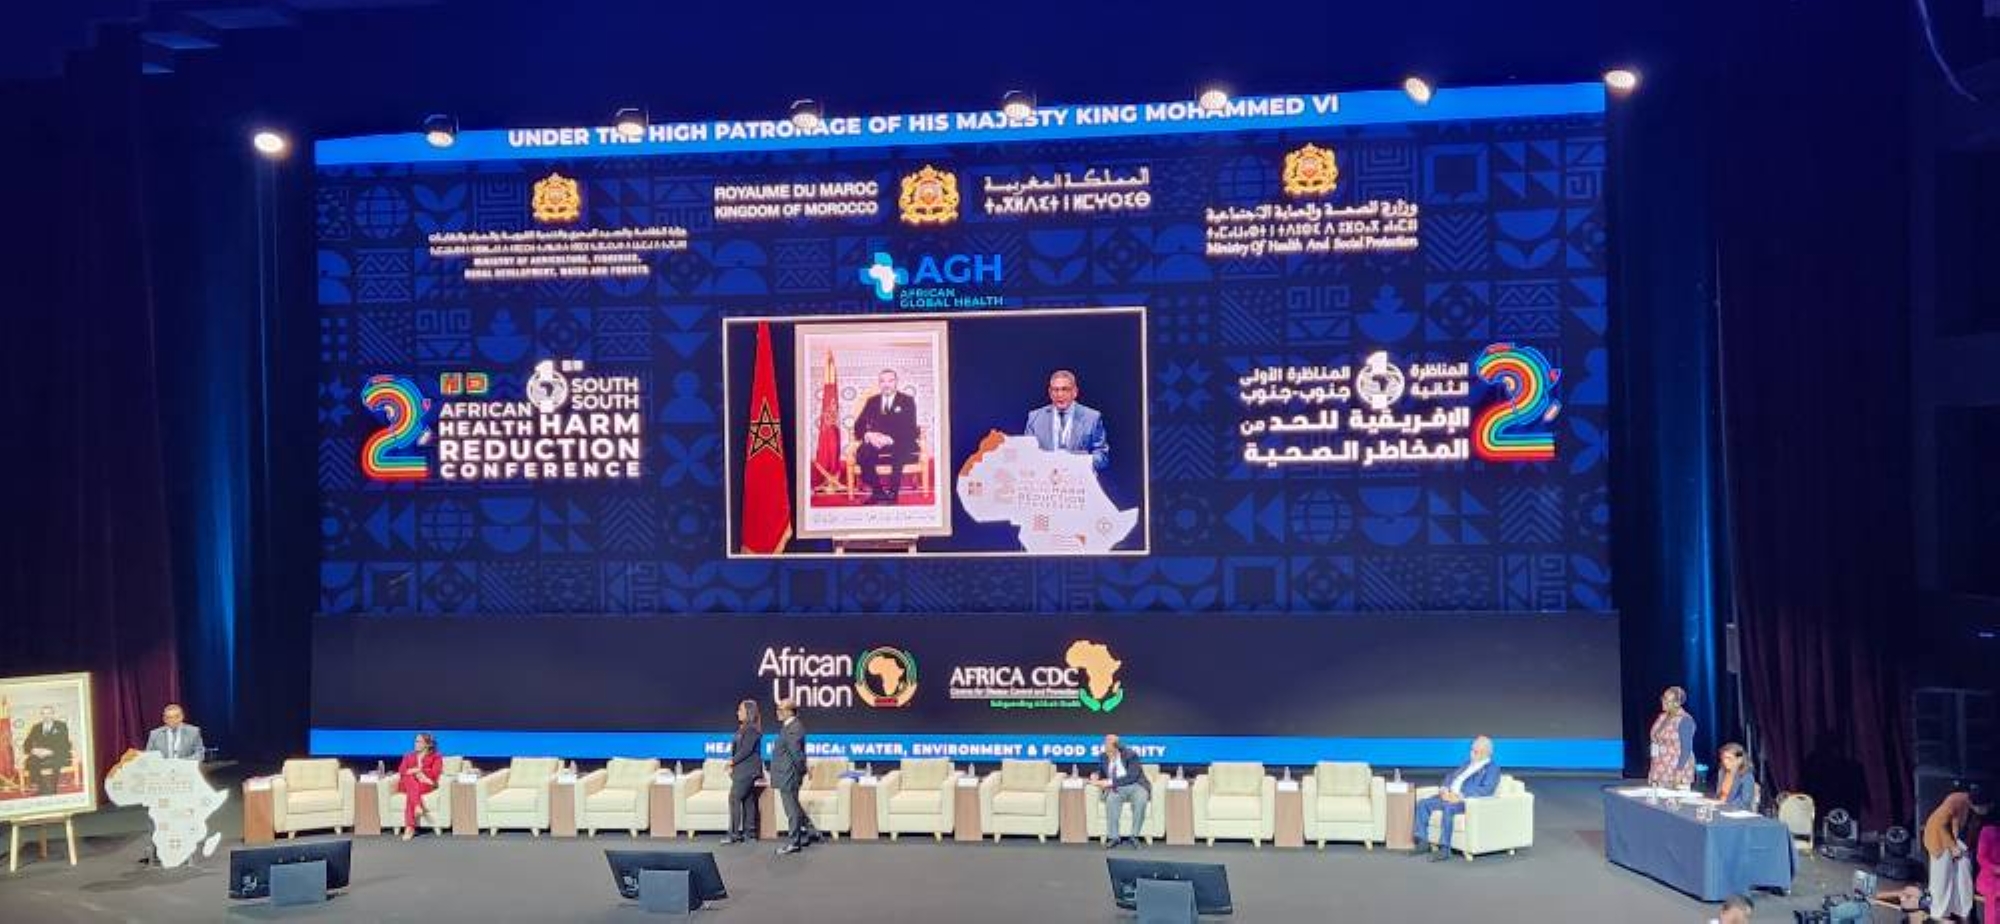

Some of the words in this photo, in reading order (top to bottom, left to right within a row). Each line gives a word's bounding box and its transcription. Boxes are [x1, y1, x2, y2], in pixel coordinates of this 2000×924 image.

[508, 128, 588, 148] UNDER
[649, 123, 708, 144] HIGH
[868, 115, 900, 134] OF
[908, 113, 949, 132] HIS
[1075, 105, 1137, 125] KING
[1312, 94, 1339, 113] VI
[984, 173, 1063, 195] المغربية
[1064, 166, 1149, 188] المملكة
[714, 183, 790, 200] ROYAUME
[793, 183, 816, 198] DU
[819, 180, 879, 198] MAROC
[714, 203, 781, 219] KINGDOM
[782, 203, 802, 217] OF
[803, 201, 879, 216] MOROCCO
[1250, 239, 1266, 255] Of
[1268, 238, 1303, 252] Health
[1306, 237, 1329, 251] And
[914, 254, 1001, 284] AGH
[900, 288, 955, 298] AFRICAN
[900, 298, 951, 308] GLOBAL
[954, 296, 1004, 307] HEALTH
[1287, 366, 1350, 384] المناظرة
[1410, 362, 1469, 380] المناظرة
[571, 377, 640, 393] SOUTH
[1410, 381, 1469, 399] الثانية
[439, 402, 532, 418] AFRICAN
[571, 394, 640, 410] SOUTH
[439, 420, 533, 437] HEALTH
[539, 412, 640, 435] HARM
[1240, 419, 1266, 435] من
[1268, 410, 1339, 432] للحد
[439, 437, 640, 461] REDUCTION
[1244, 440, 1359, 467] الصحية
[1362, 438, 1470, 466] المخاطر
[440, 462, 640, 479] CONFERENCE
[758, 646, 853, 678] African
[950, 666, 1026, 687] AFRICA
[1031, 666, 1080, 687] CDC
[773, 678, 853, 707] Union
[704, 742, 733, 754] HEA
[805, 742, 846, 755] RICA:
[850, 743, 907, 757] WATER,
[912, 744, 1023, 756] ENVIRONMENT
[1027, 744, 1037, 756] &
[1042, 744, 1086, 757] FOOD
[1090, 744, 1166, 757] SRITY
